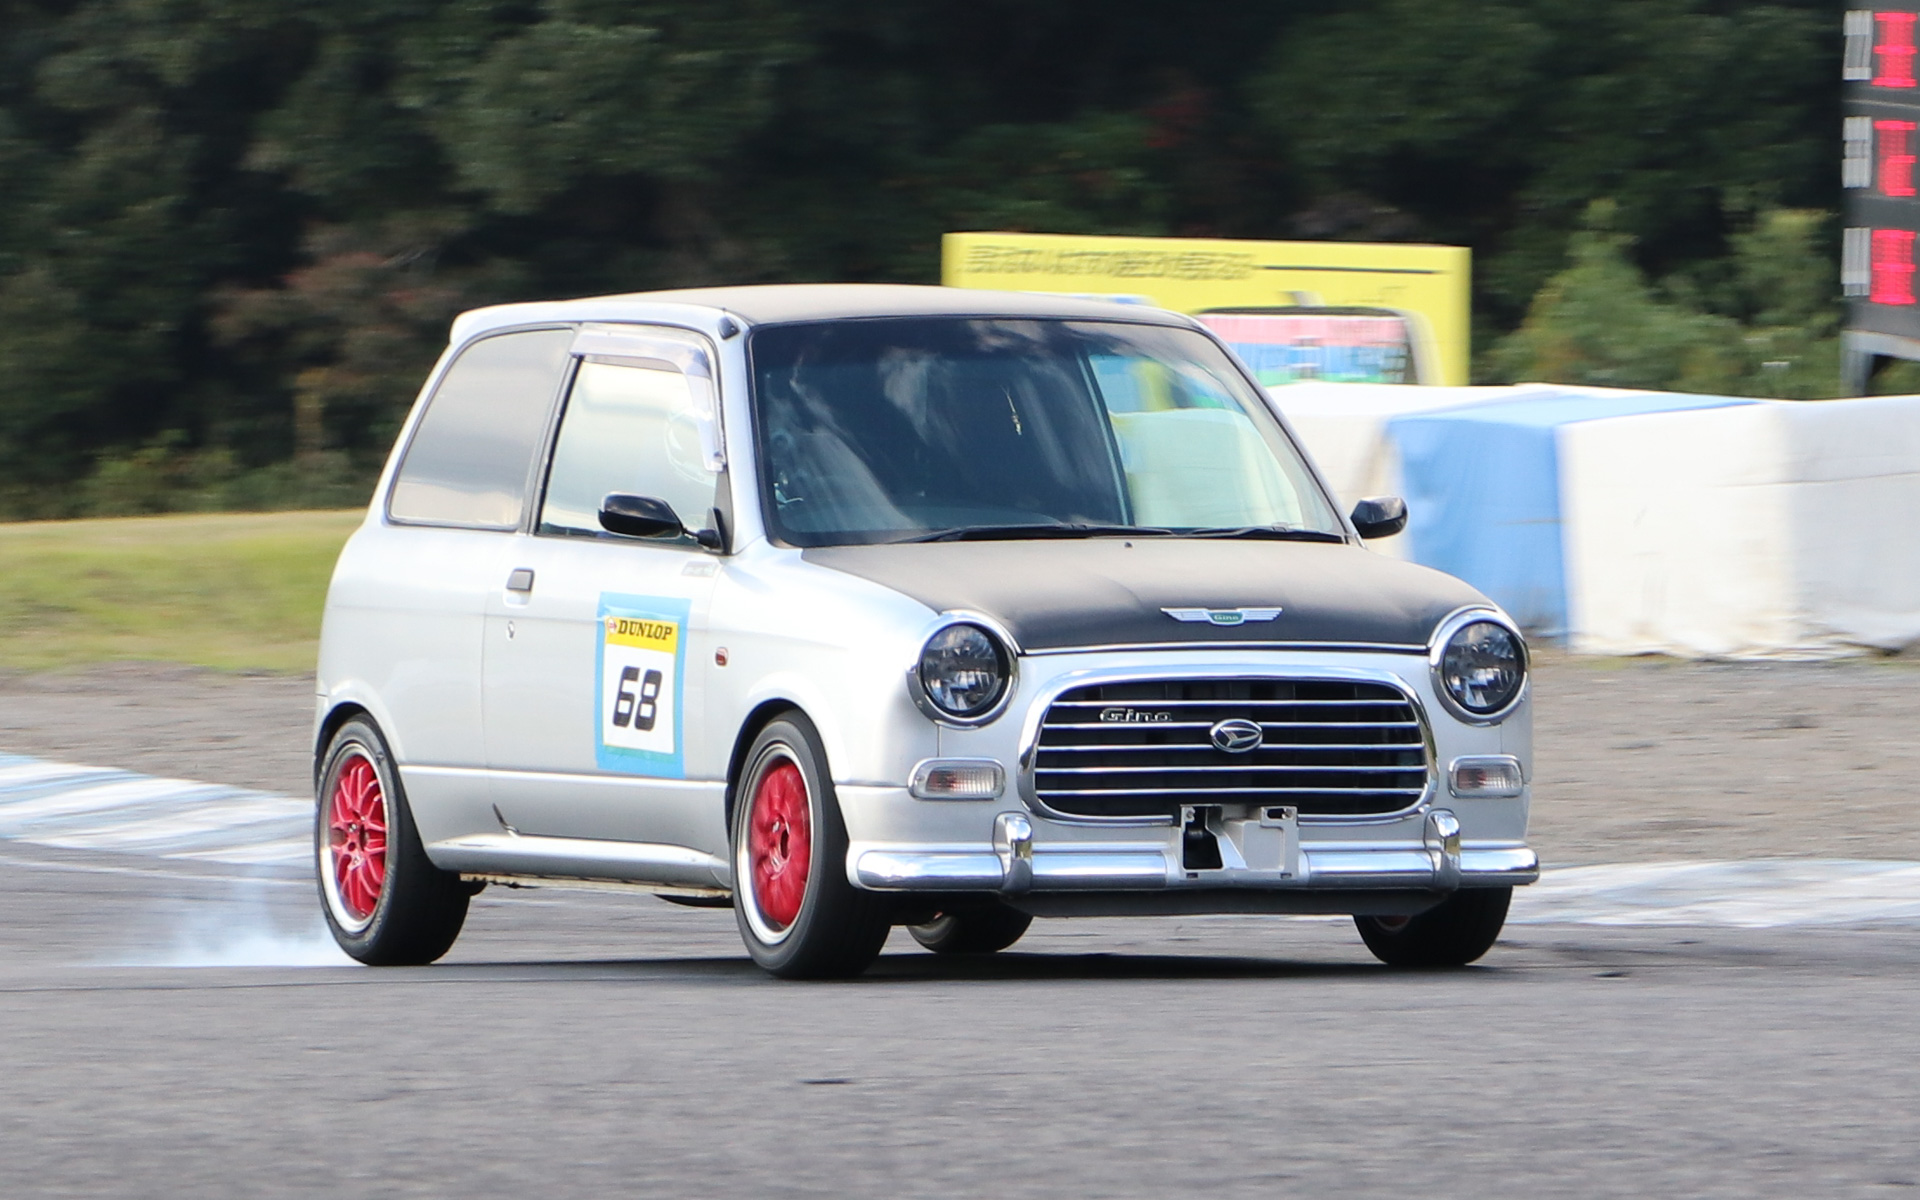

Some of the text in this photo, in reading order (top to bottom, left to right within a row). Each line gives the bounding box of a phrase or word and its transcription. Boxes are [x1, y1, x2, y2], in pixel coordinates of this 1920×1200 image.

[1213, 613, 1240, 621] Gino
[618, 619, 673, 641] DUNLOP
[612, 665, 663, 732] 68
[1099, 707, 1173, 722] Gino
